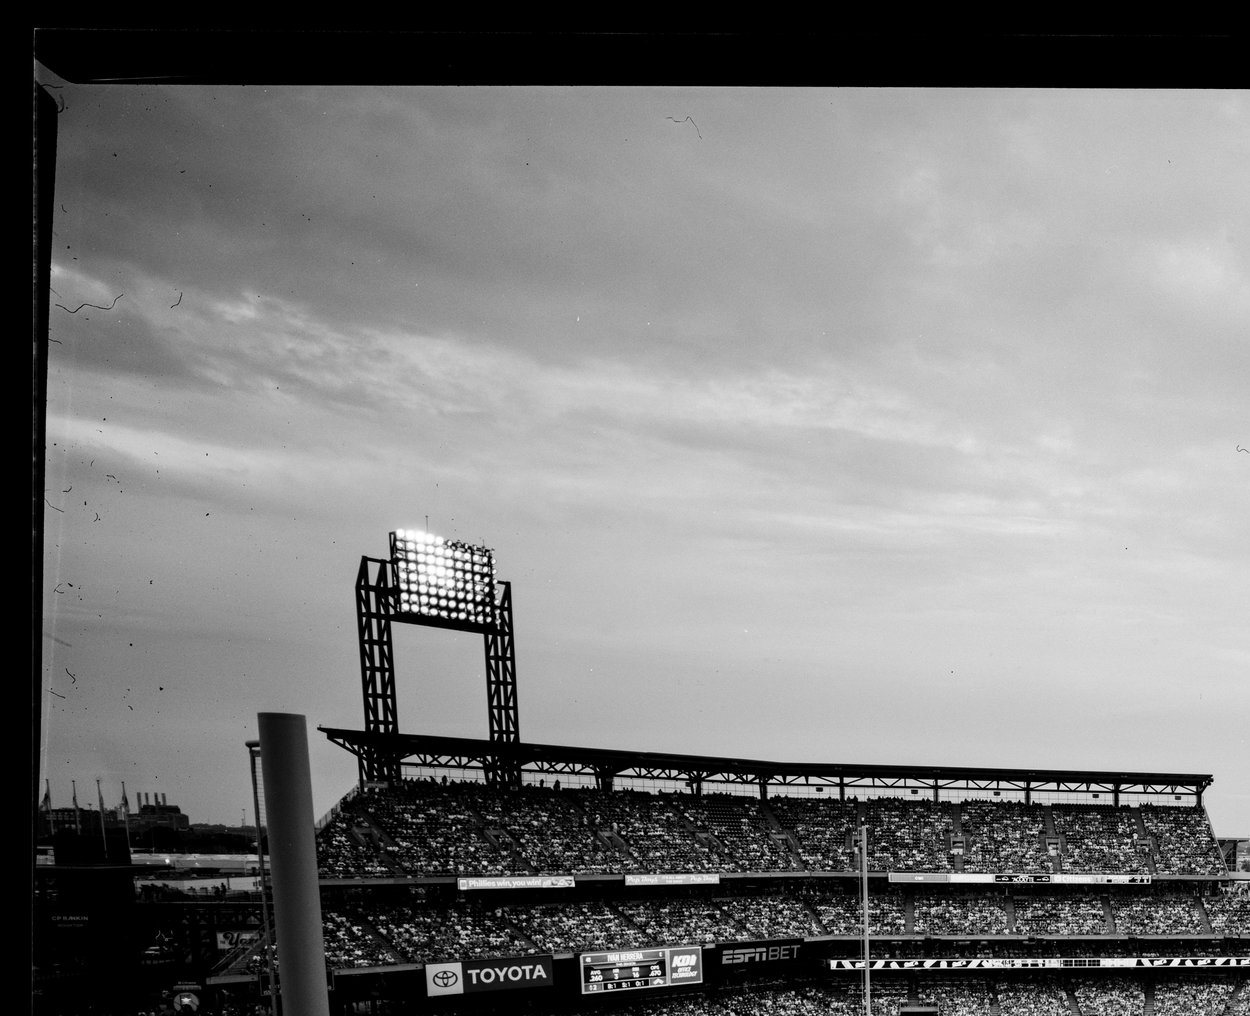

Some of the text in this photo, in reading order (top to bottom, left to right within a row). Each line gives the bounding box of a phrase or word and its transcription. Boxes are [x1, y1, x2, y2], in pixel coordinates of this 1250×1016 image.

[468, 879, 496, 887] Phillies
[512, 880, 526, 888] you
[721, 944, 801, 965] ESPN BET
[467, 964, 547, 985] TOYOTA
